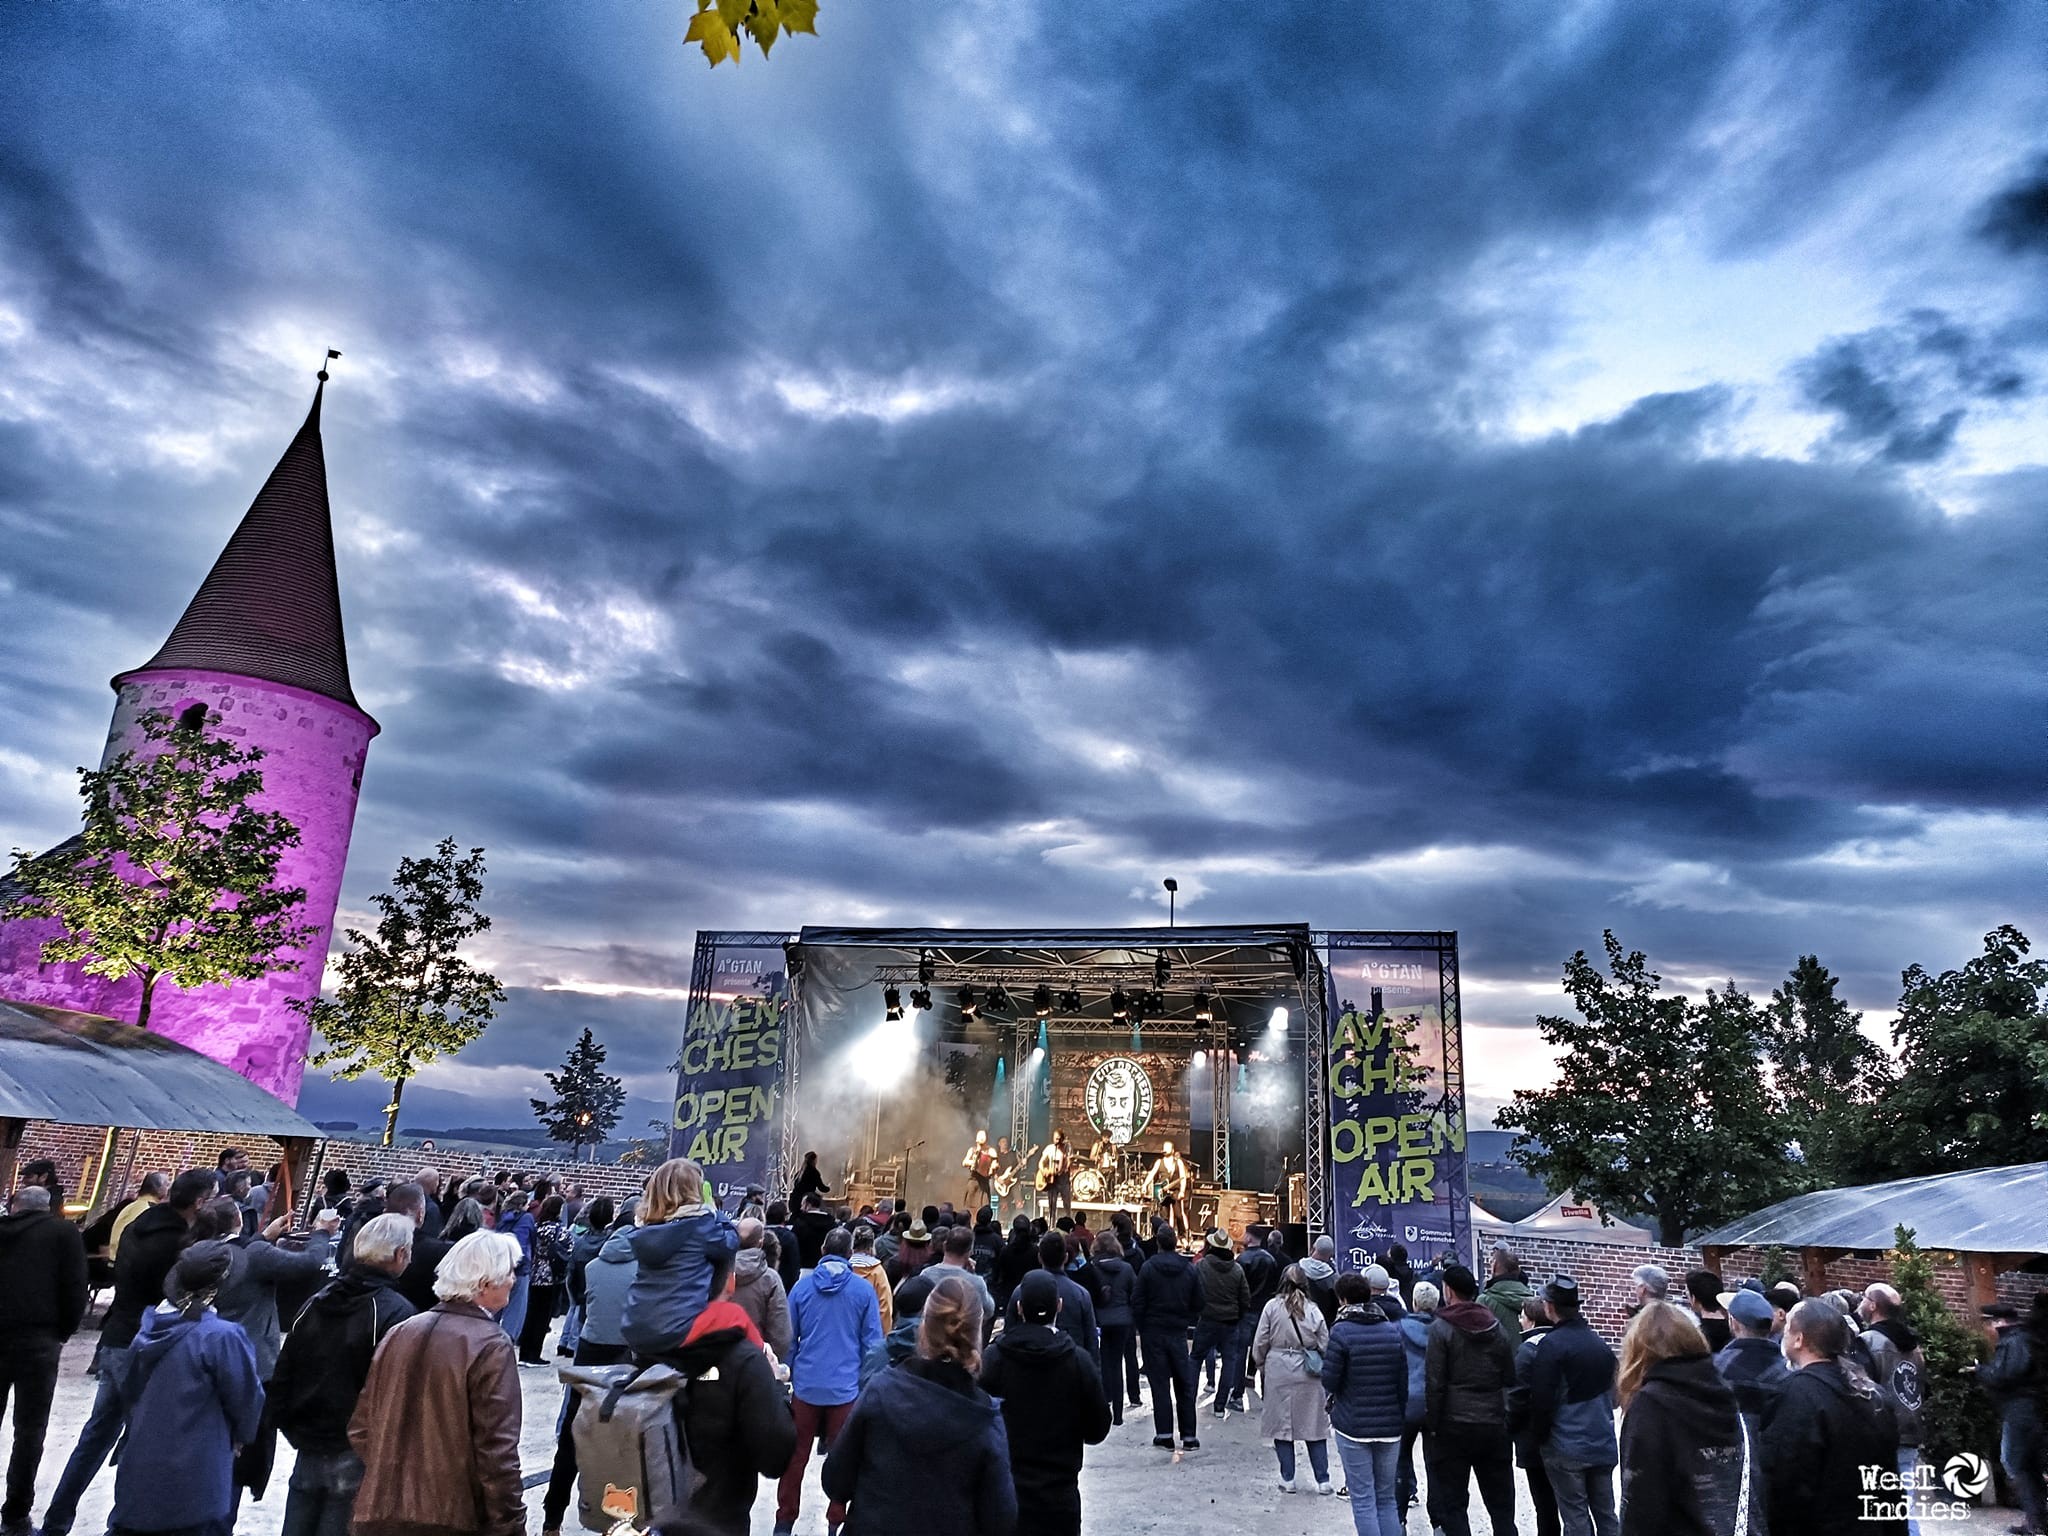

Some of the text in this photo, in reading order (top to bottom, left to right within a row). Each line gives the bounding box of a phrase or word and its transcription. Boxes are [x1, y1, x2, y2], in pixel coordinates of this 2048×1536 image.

[686, 991, 782, 1038] AVEN
[682, 1029, 781, 1076] CHES
[673, 1083, 776, 1130] OPEN
[1096, 1061, 1116, 1082] CITY
[1118, 1061, 1150, 1117] ORCHESTRA
[686, 1125, 749, 1166] AIR
[1331, 1109, 1466, 1163] OPEN
[1351, 1158, 1435, 1208] AIR
[1420, 1228, 1453, 1237] Commune
